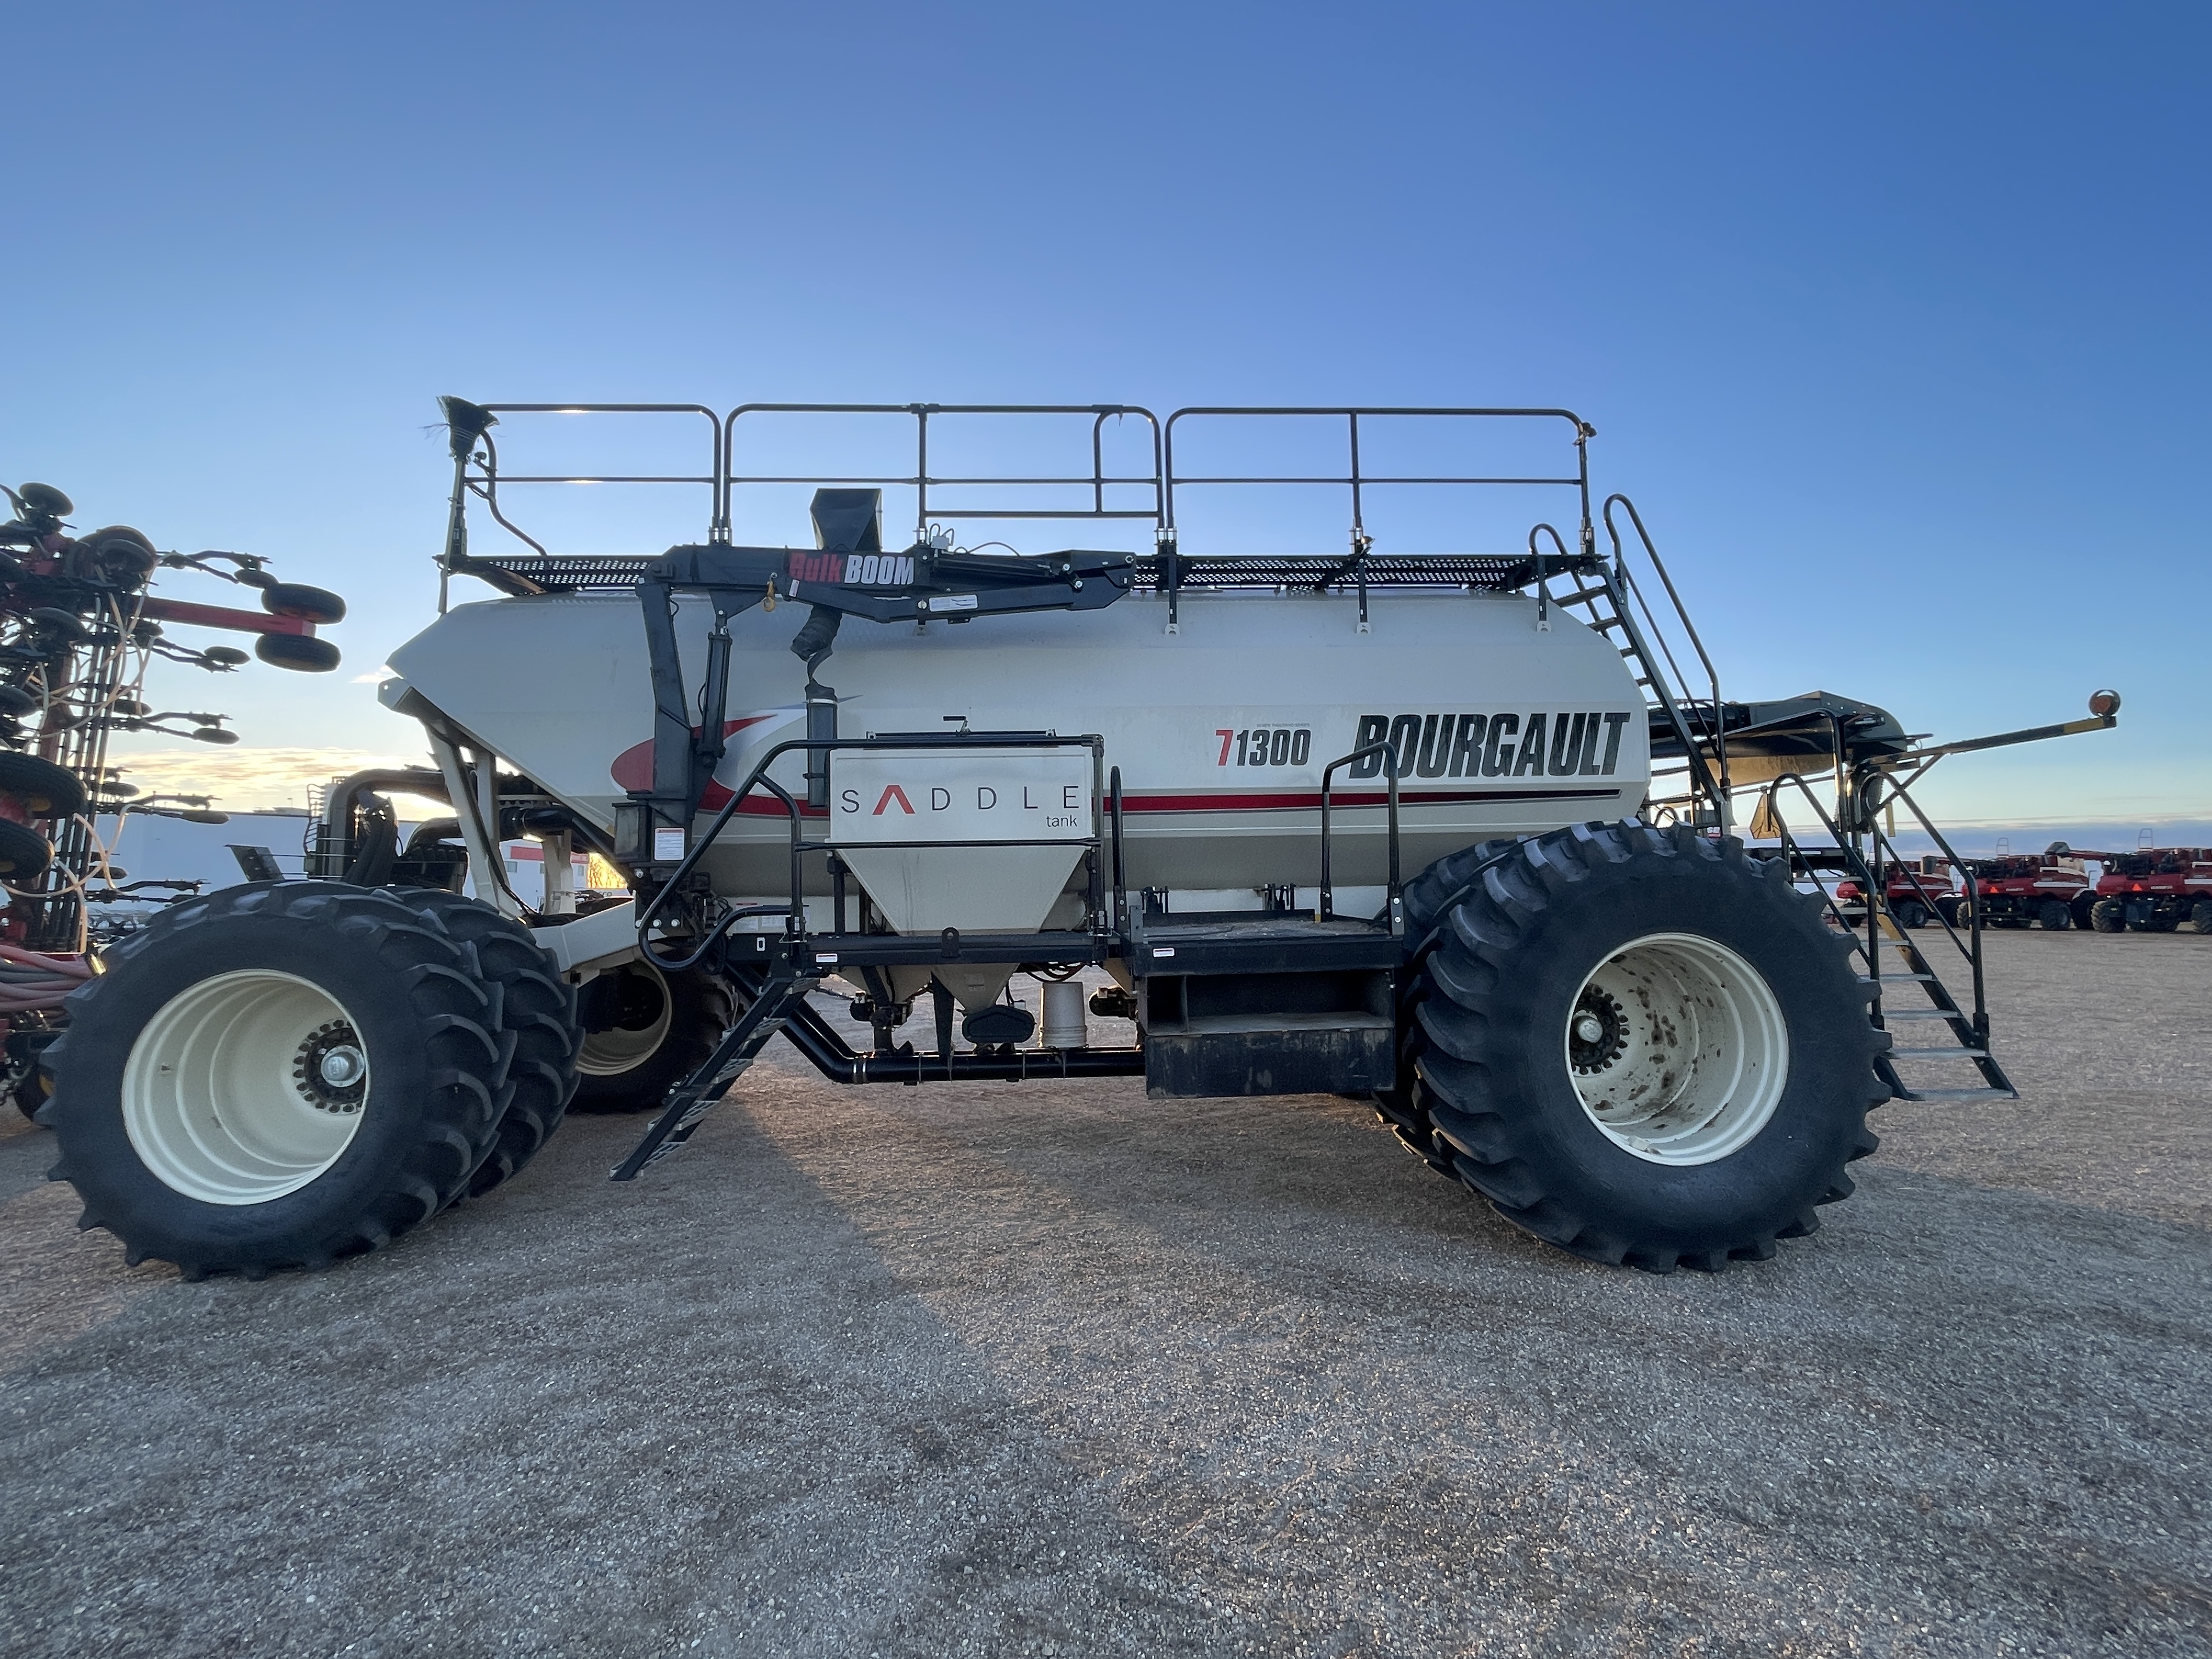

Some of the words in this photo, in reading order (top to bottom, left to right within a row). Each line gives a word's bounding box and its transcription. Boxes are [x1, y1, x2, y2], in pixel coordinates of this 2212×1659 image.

[844, 554, 915, 585] BOOM
[1216, 729, 1311, 766] 71300
[1348, 712, 1631, 779] BOURGAULT
[841, 784, 1080, 815] SADDLE
[1046, 814, 1077, 827] tank
